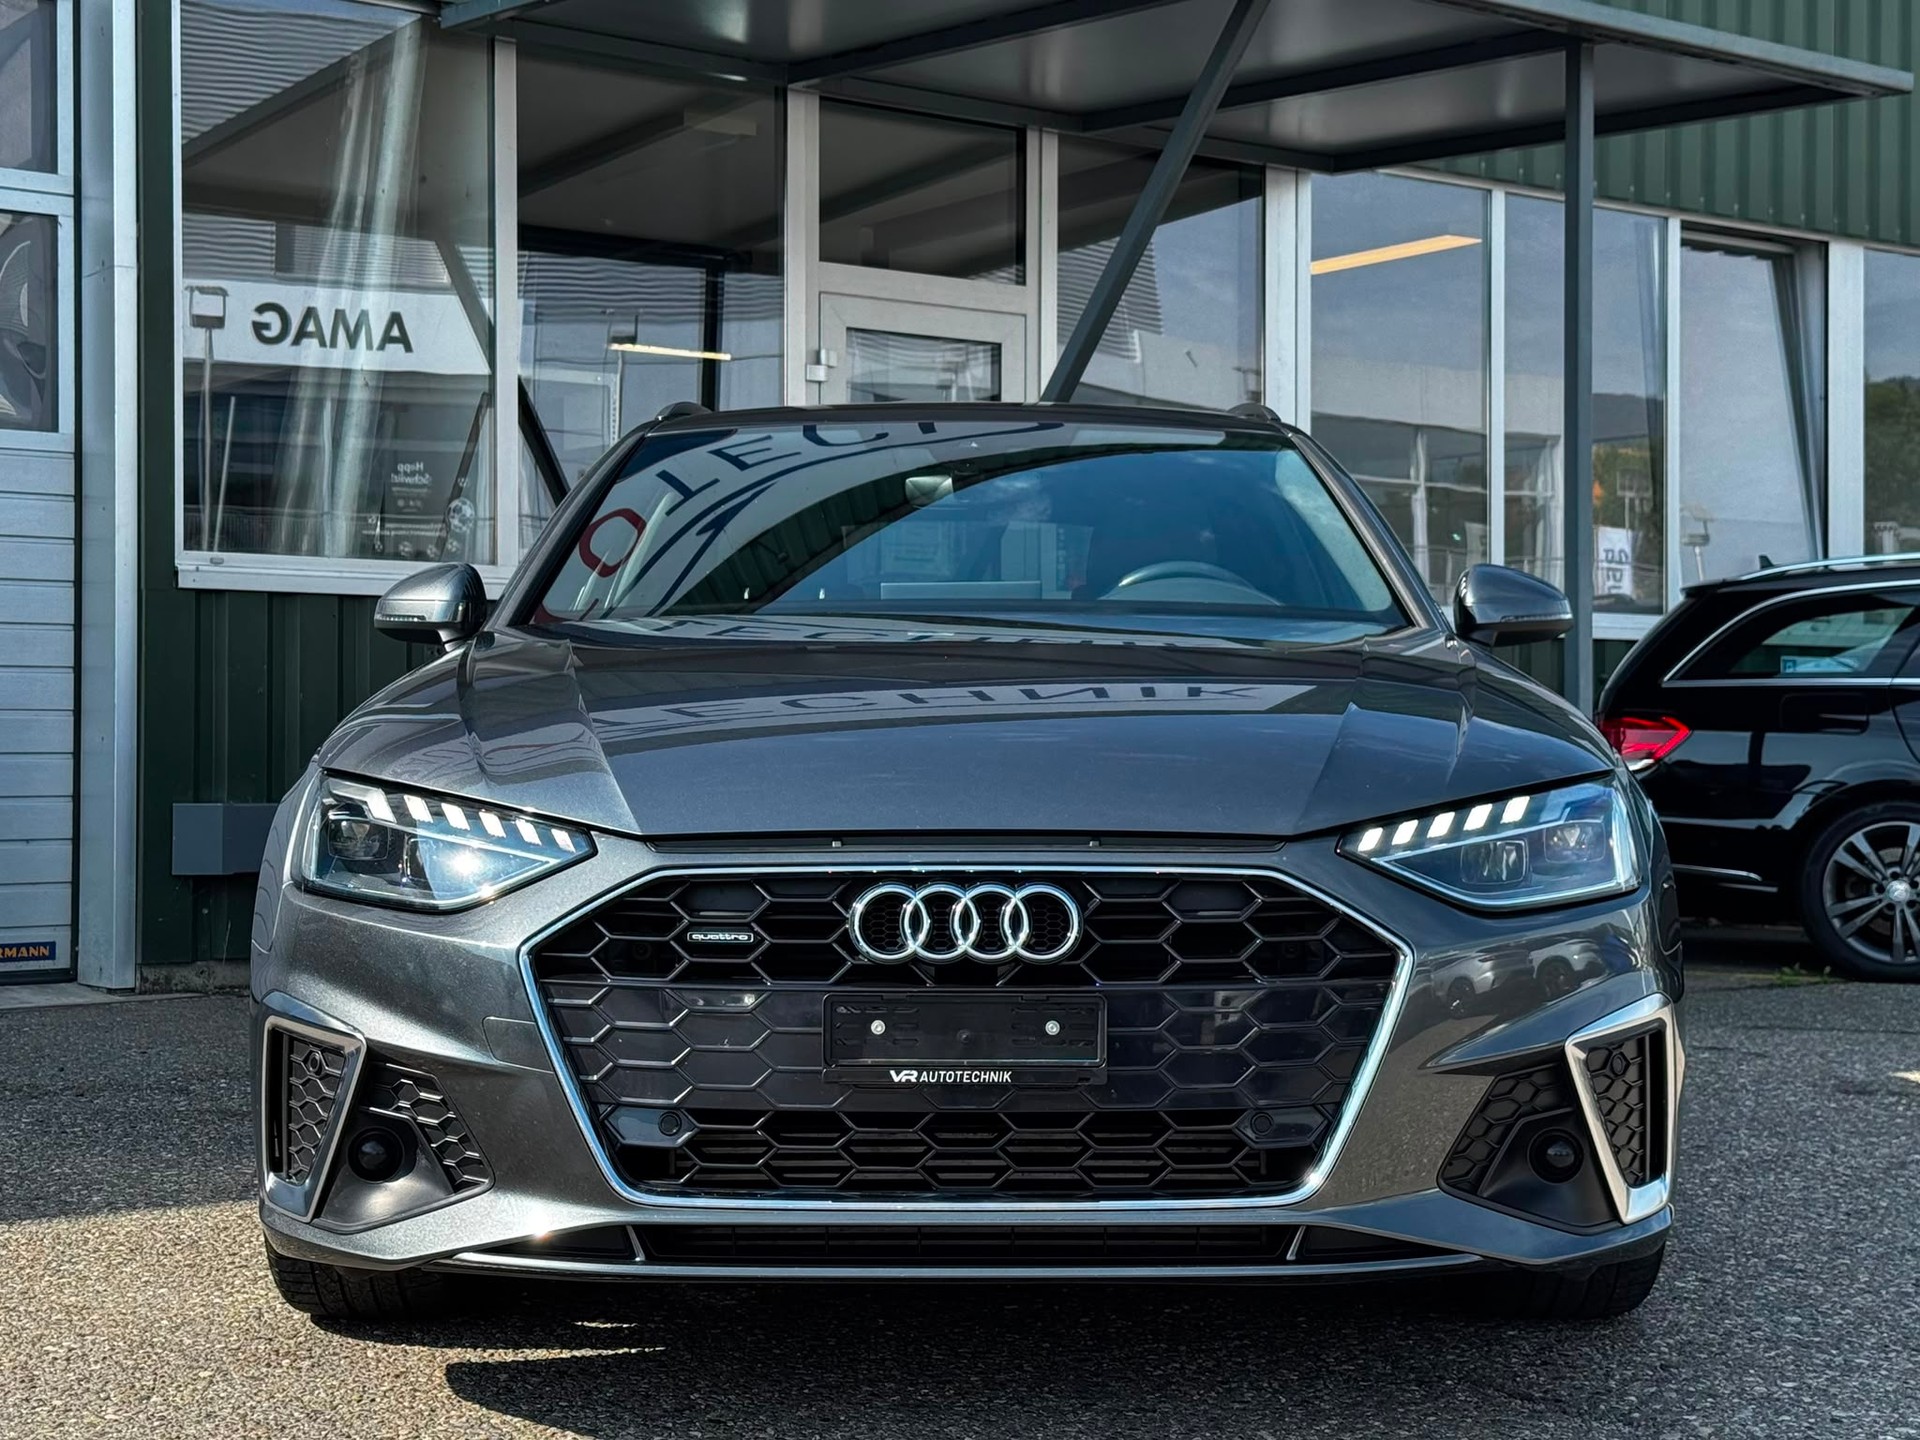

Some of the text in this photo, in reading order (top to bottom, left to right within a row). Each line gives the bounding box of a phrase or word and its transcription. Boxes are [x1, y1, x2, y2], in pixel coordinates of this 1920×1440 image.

[692, 933, 748, 941] quattro
[889, 1070, 1012, 1083] VR AUTOTECHNIK
